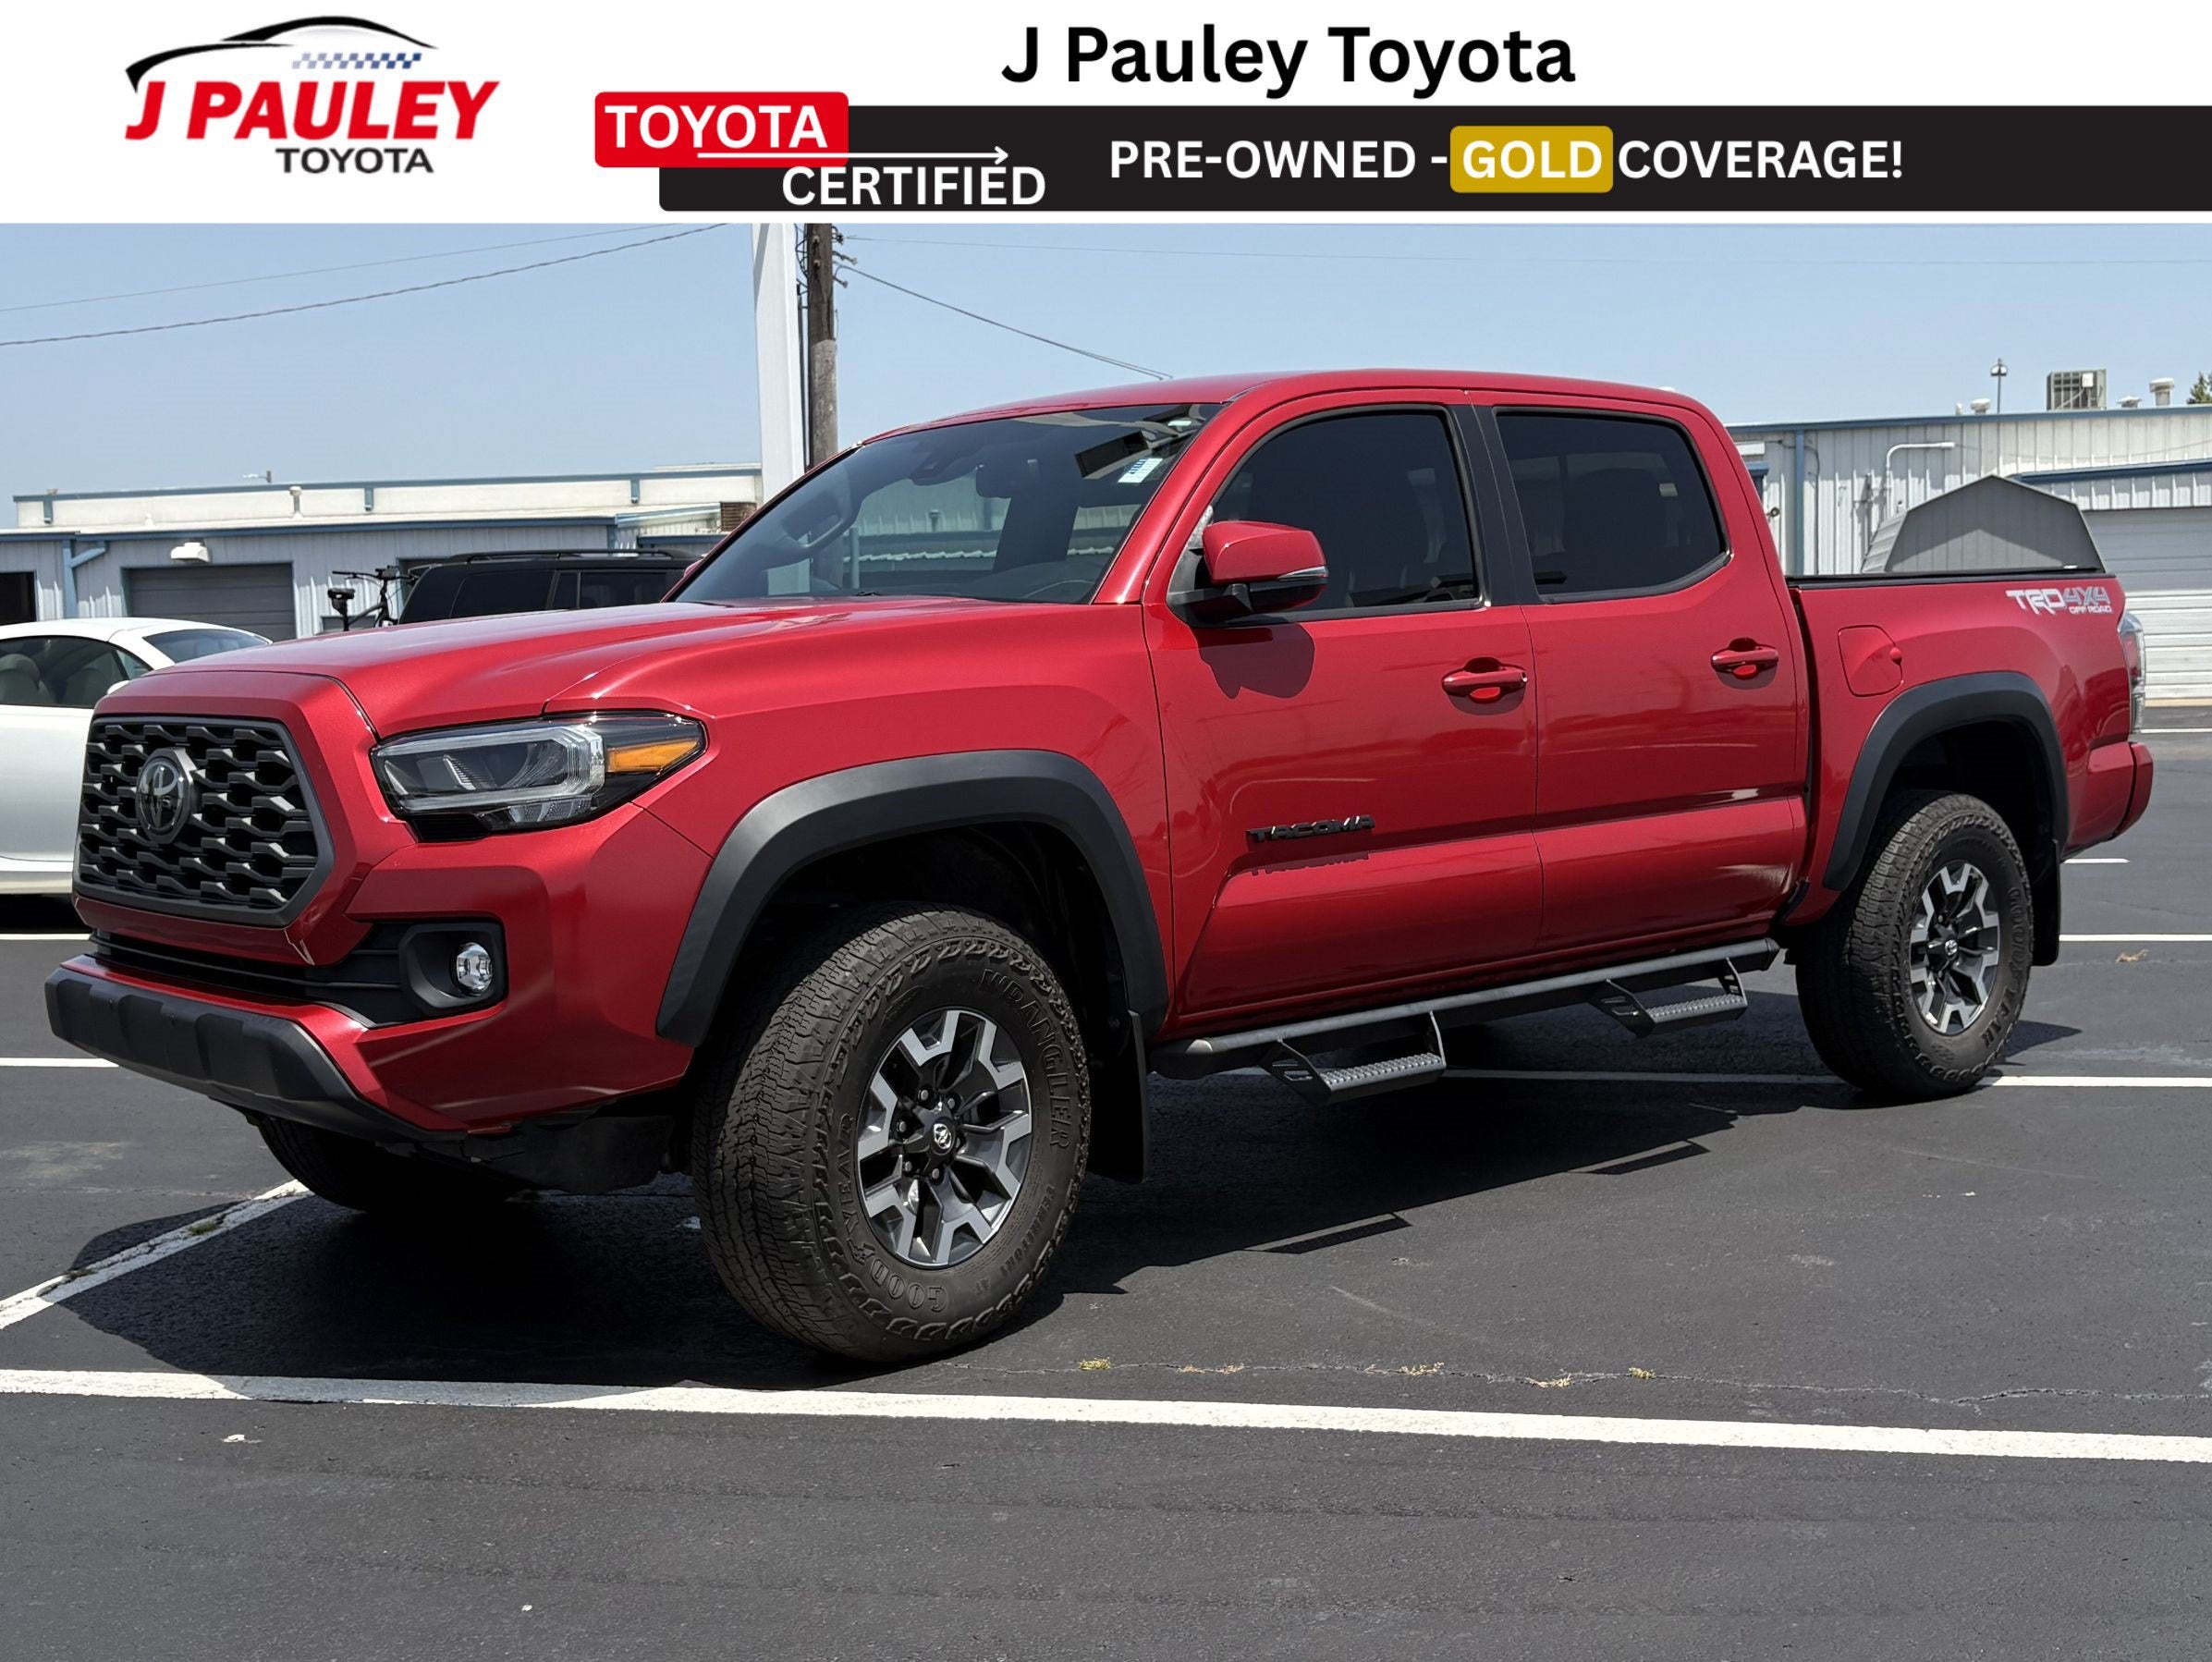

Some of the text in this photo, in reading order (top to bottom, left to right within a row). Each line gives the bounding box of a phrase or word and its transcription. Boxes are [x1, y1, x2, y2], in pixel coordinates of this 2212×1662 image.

[2087, 605, 2113, 615] ROAD
[1245, 814, 1376, 842] TACOMA
[980, 968, 1072, 1149] WRANGLER
